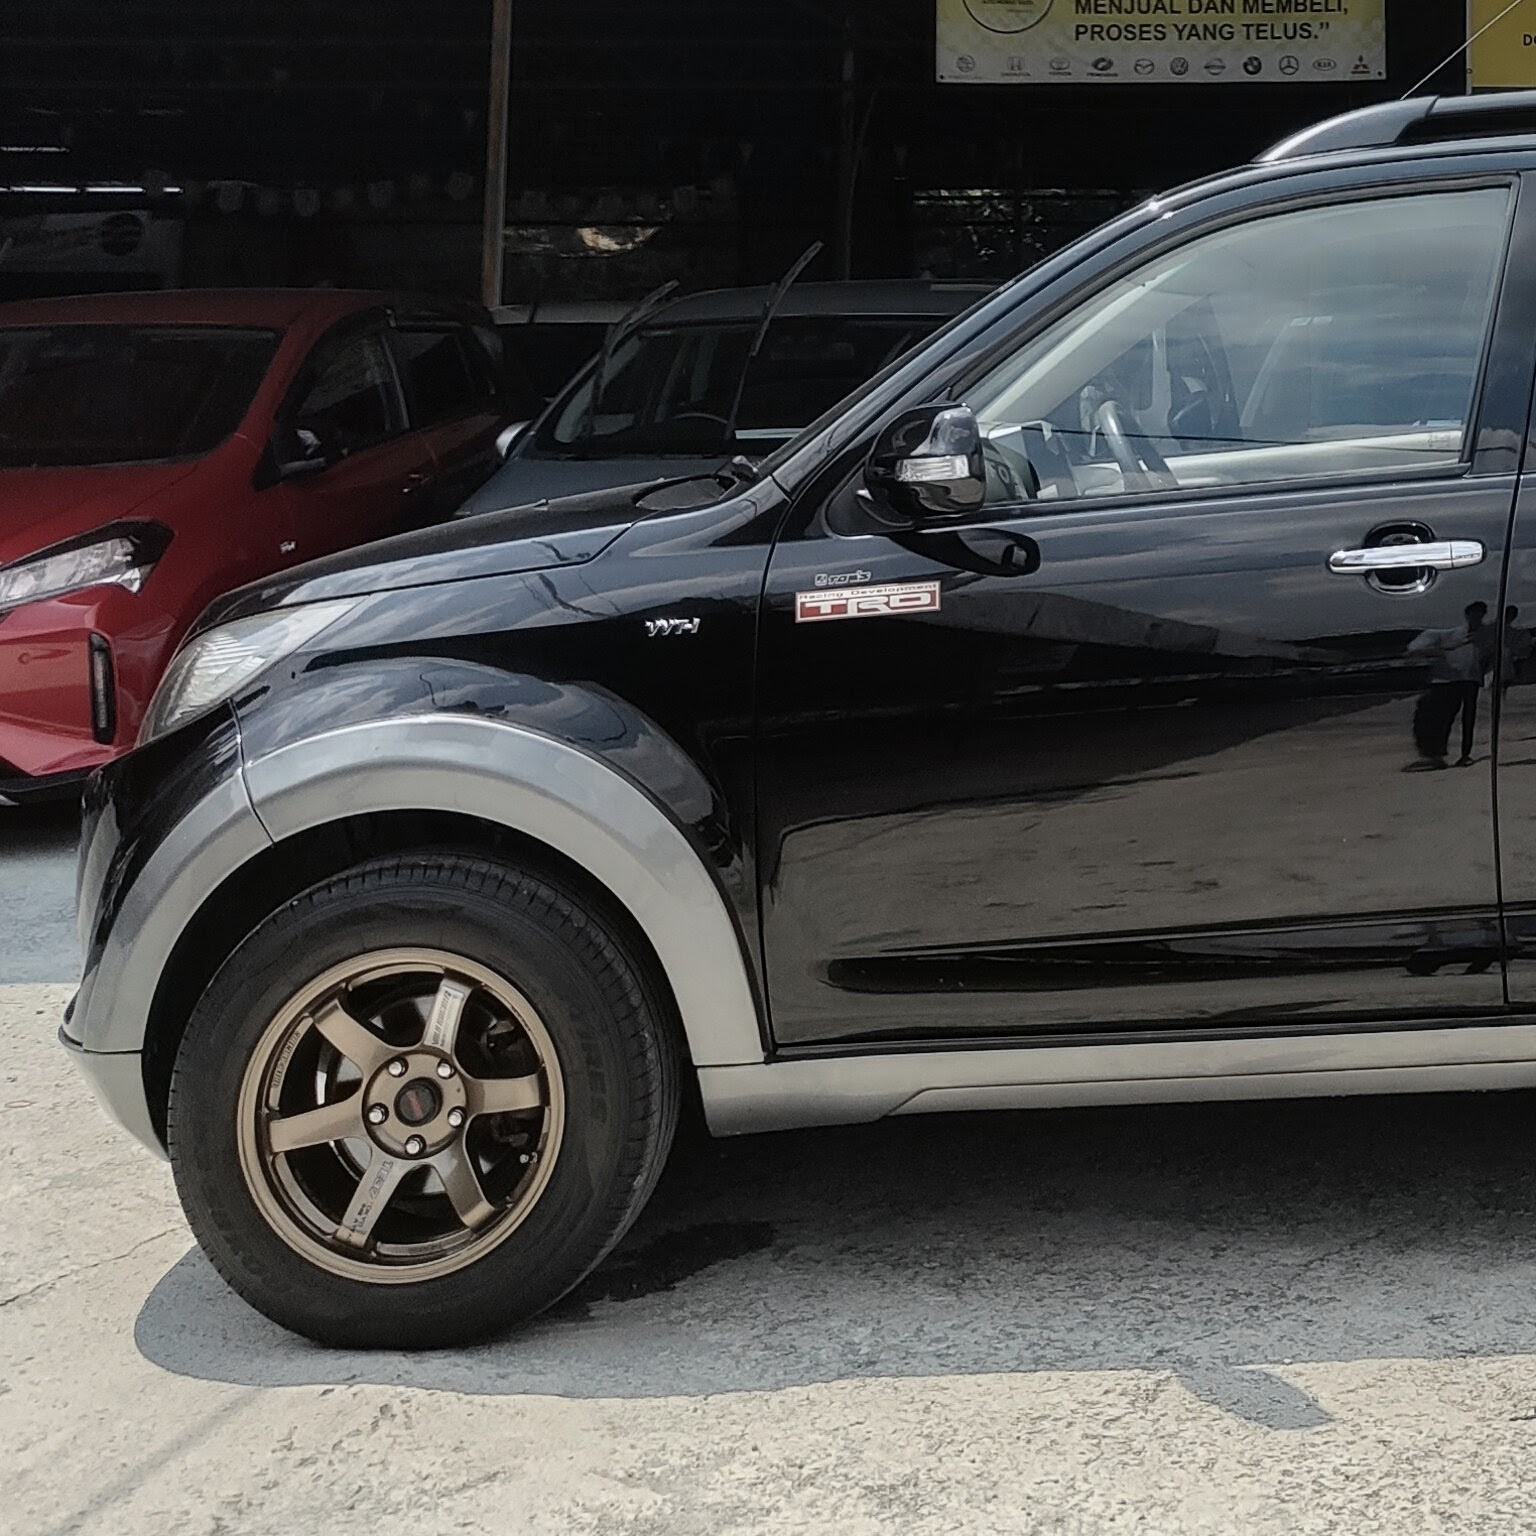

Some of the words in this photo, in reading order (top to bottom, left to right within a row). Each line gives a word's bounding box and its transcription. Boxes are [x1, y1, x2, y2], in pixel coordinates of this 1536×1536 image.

[1074, 23, 1167, 42] PROSES
[1170, 23, 1237, 42] YANG
[850, 583, 937, 596] Development
[804, 591, 932, 616] TRD
